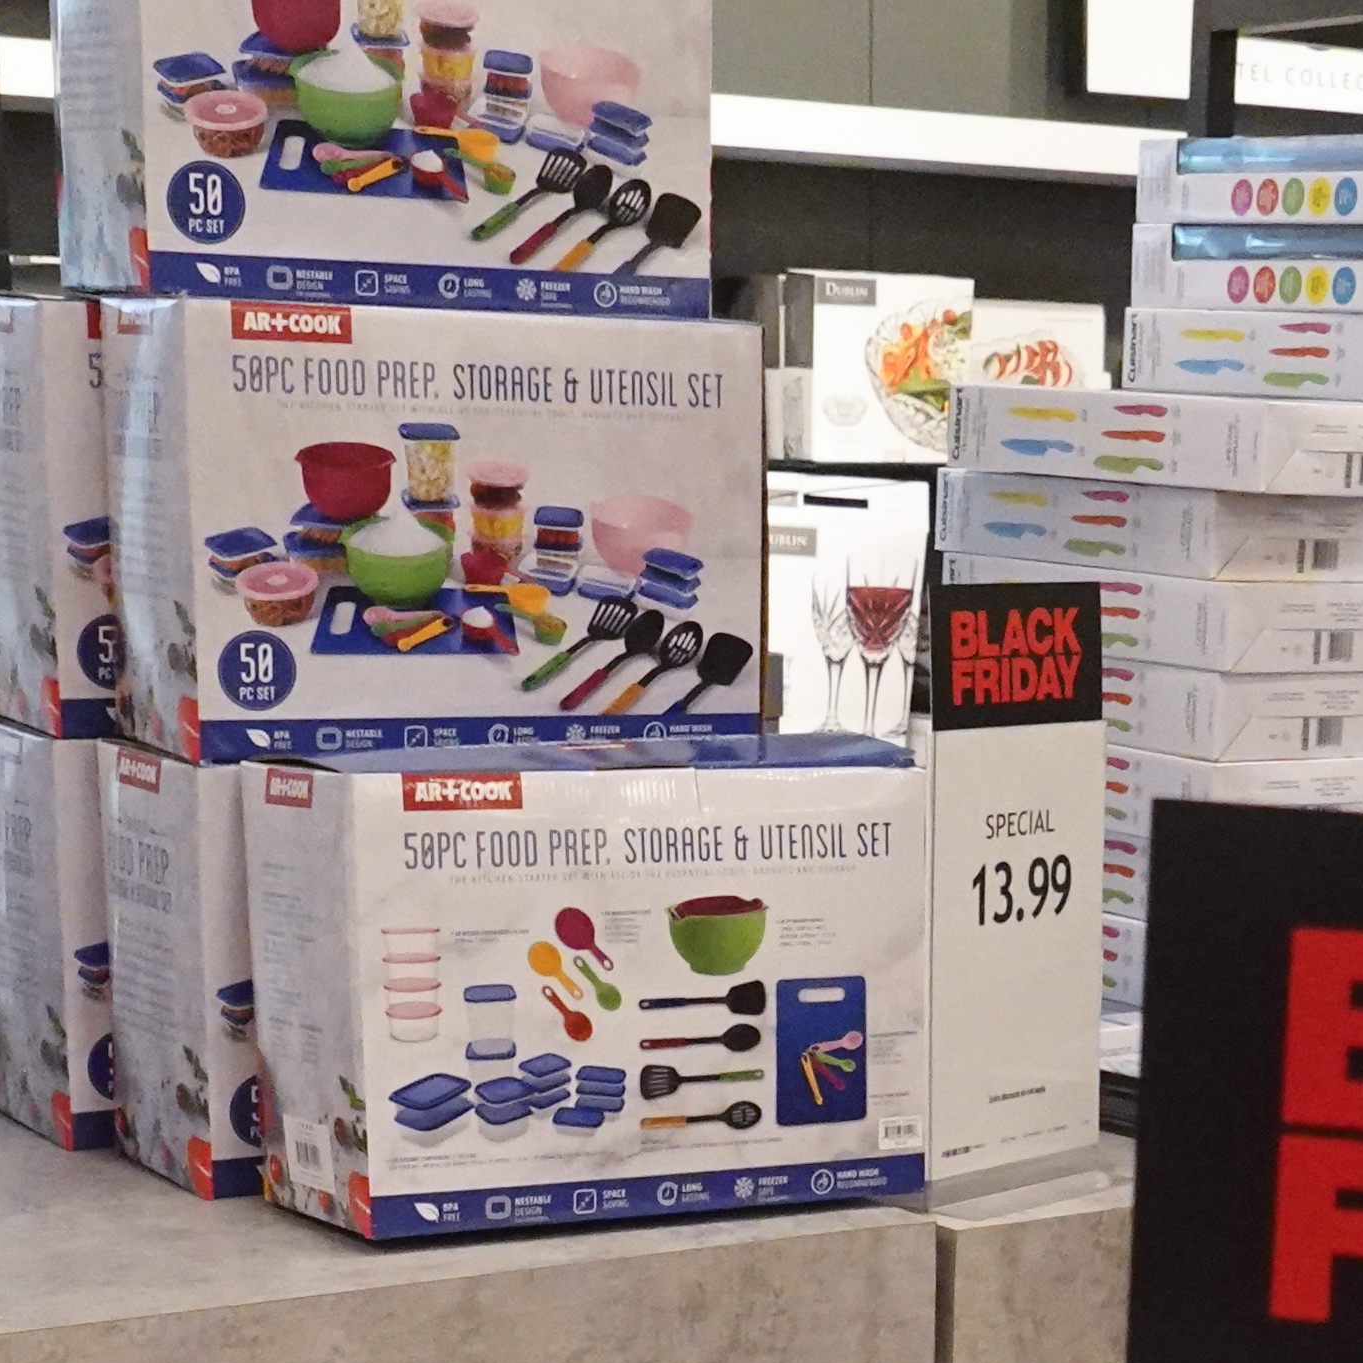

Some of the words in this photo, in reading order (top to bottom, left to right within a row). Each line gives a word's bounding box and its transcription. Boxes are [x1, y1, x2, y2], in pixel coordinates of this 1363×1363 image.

[188, 172, 223, 216] 50
[188, 218, 203, 233] PC
[205, 219, 225, 235] SET
[243, 311, 343, 335] AR+COOK
[232, 355, 295, 395] 50PC
[304, 358, 366, 396] FOOD
[453, 363, 553, 402] STORAGE
[564, 367, 579, 404] &
[591, 368, 678, 408] UTENSIL
[688, 373, 724, 409] SET
[952, 387, 964, 461] Cuisinart
[950, 607, 1083, 658] BLACK
[240, 643, 274, 683] 50
[951, 654, 1082, 706] FRIDAY
[239, 687, 254, 699] PC
[256, 686, 275, 701] SET
[415, 780, 513, 802] AR+COOK
[986, 809, 1055, 839] SPECIAL
[404, 832, 467, 870] 50PC
[476, 830, 539, 870] FOOD
[624, 826, 723, 864] STORAGE
[735, 825, 749, 861] &
[760, 823, 847, 860] UTENSIL
[857, 822, 892, 857] SET
[972, 854, 1072, 927] 13.99
[602, 1188, 626, 1199] SPACE
[681, 1182, 703, 1192] LONG
